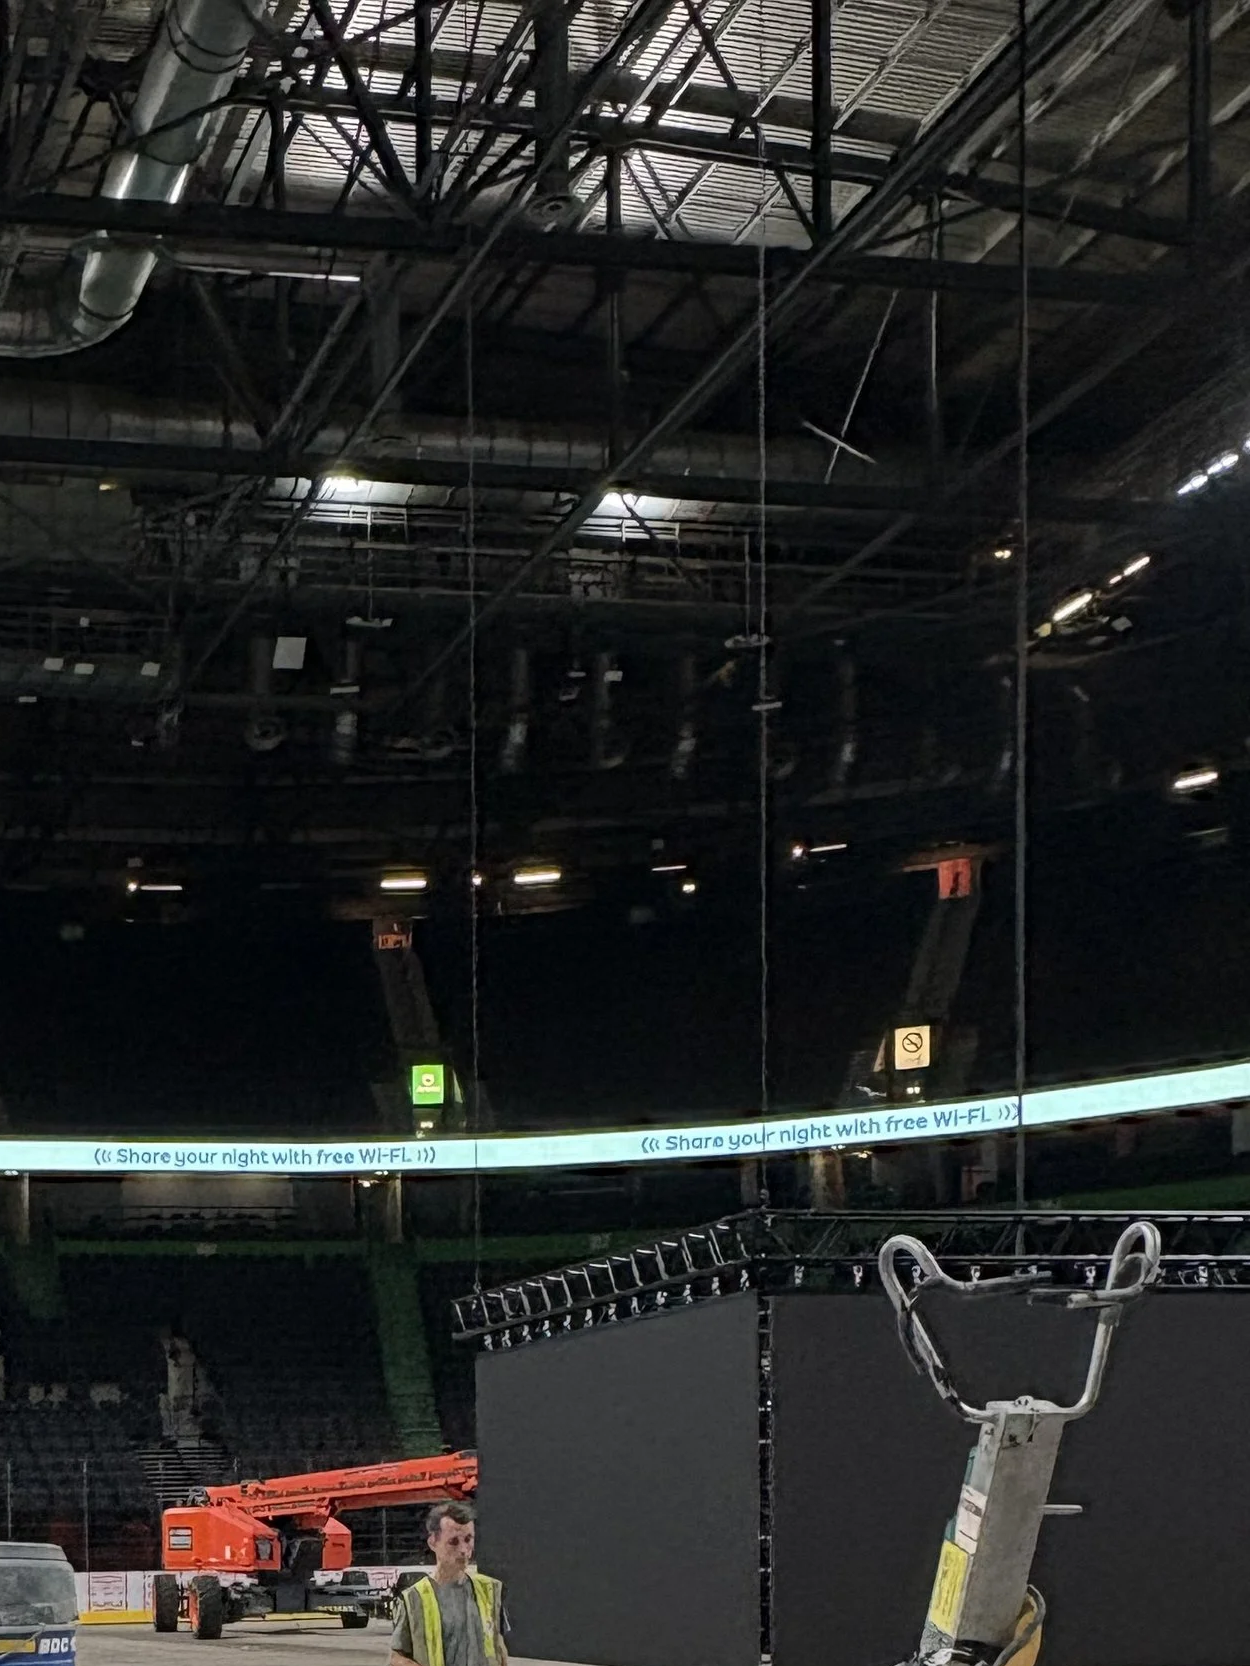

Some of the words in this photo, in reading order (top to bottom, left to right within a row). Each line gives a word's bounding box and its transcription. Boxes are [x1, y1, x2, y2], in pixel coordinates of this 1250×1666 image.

[665, 1135, 724, 1151] Share
[728, 1131, 776, 1150] your
[780, 1124, 832, 1144] night
[836, 1117, 880, 1137] with
[885, 1115, 928, 1133] free
[116, 1148, 171, 1163] Share
[174, 1150, 218, 1167] your
[222, 1148, 269, 1167] night
[272, 1148, 312, 1165] with
[317, 1149, 354, 1164] free
